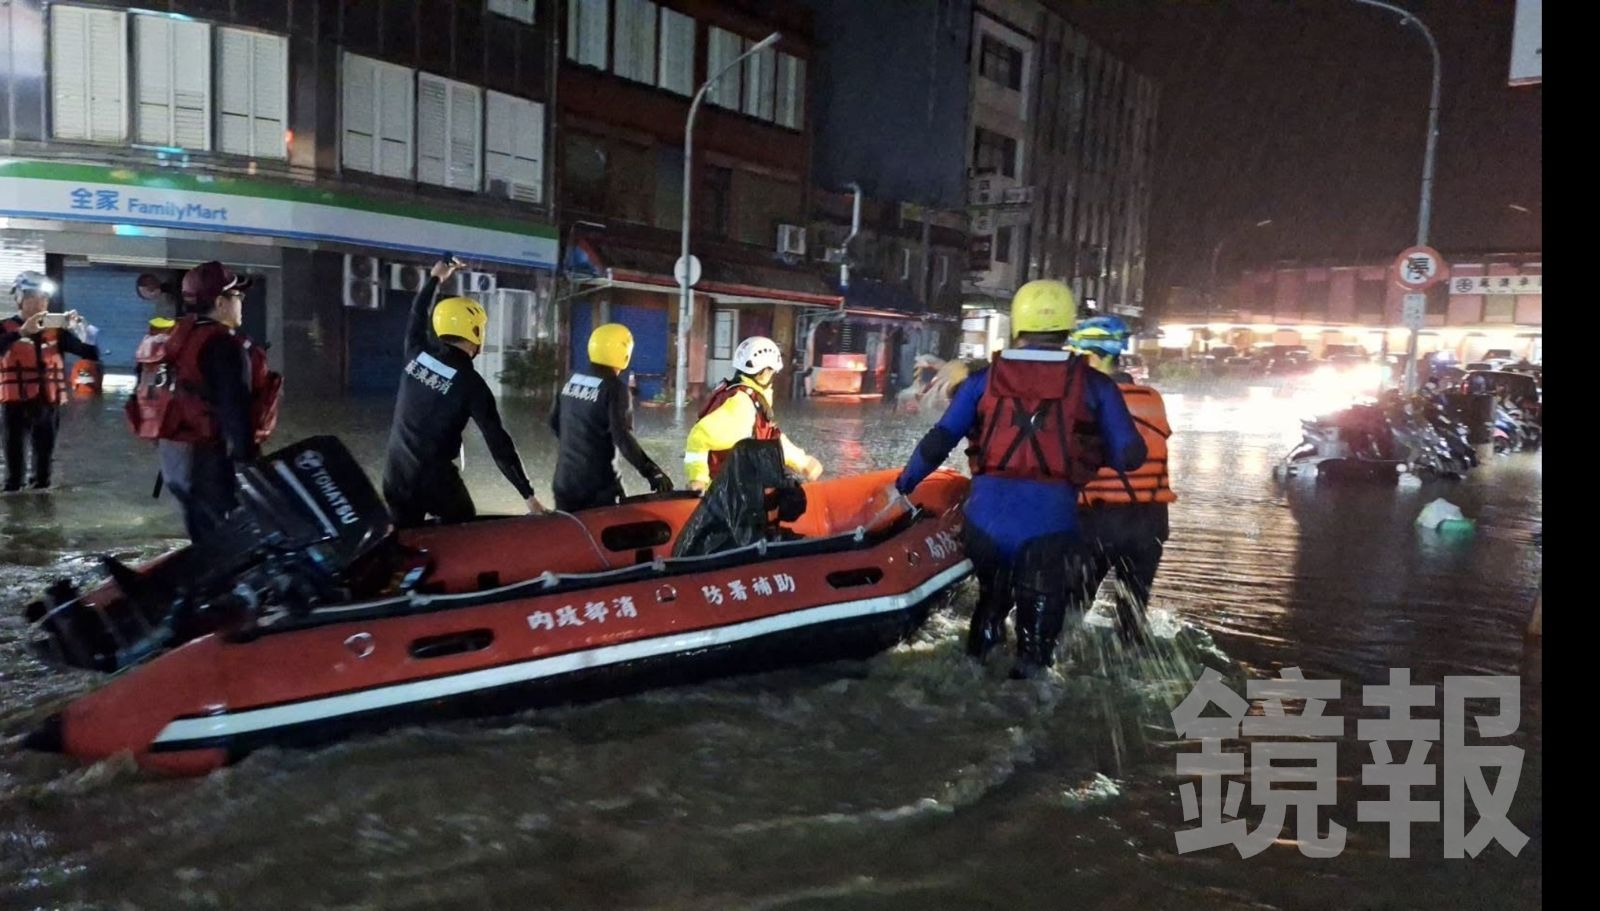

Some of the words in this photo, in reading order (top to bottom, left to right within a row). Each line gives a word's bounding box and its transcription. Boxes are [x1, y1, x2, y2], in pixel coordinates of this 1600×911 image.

[70, 187, 119, 211] 全家
[127, 198, 228, 221] FamilyMart
[311, 469, 359, 524] TOHATSU
[701, 573, 796, 605] 防署補助
